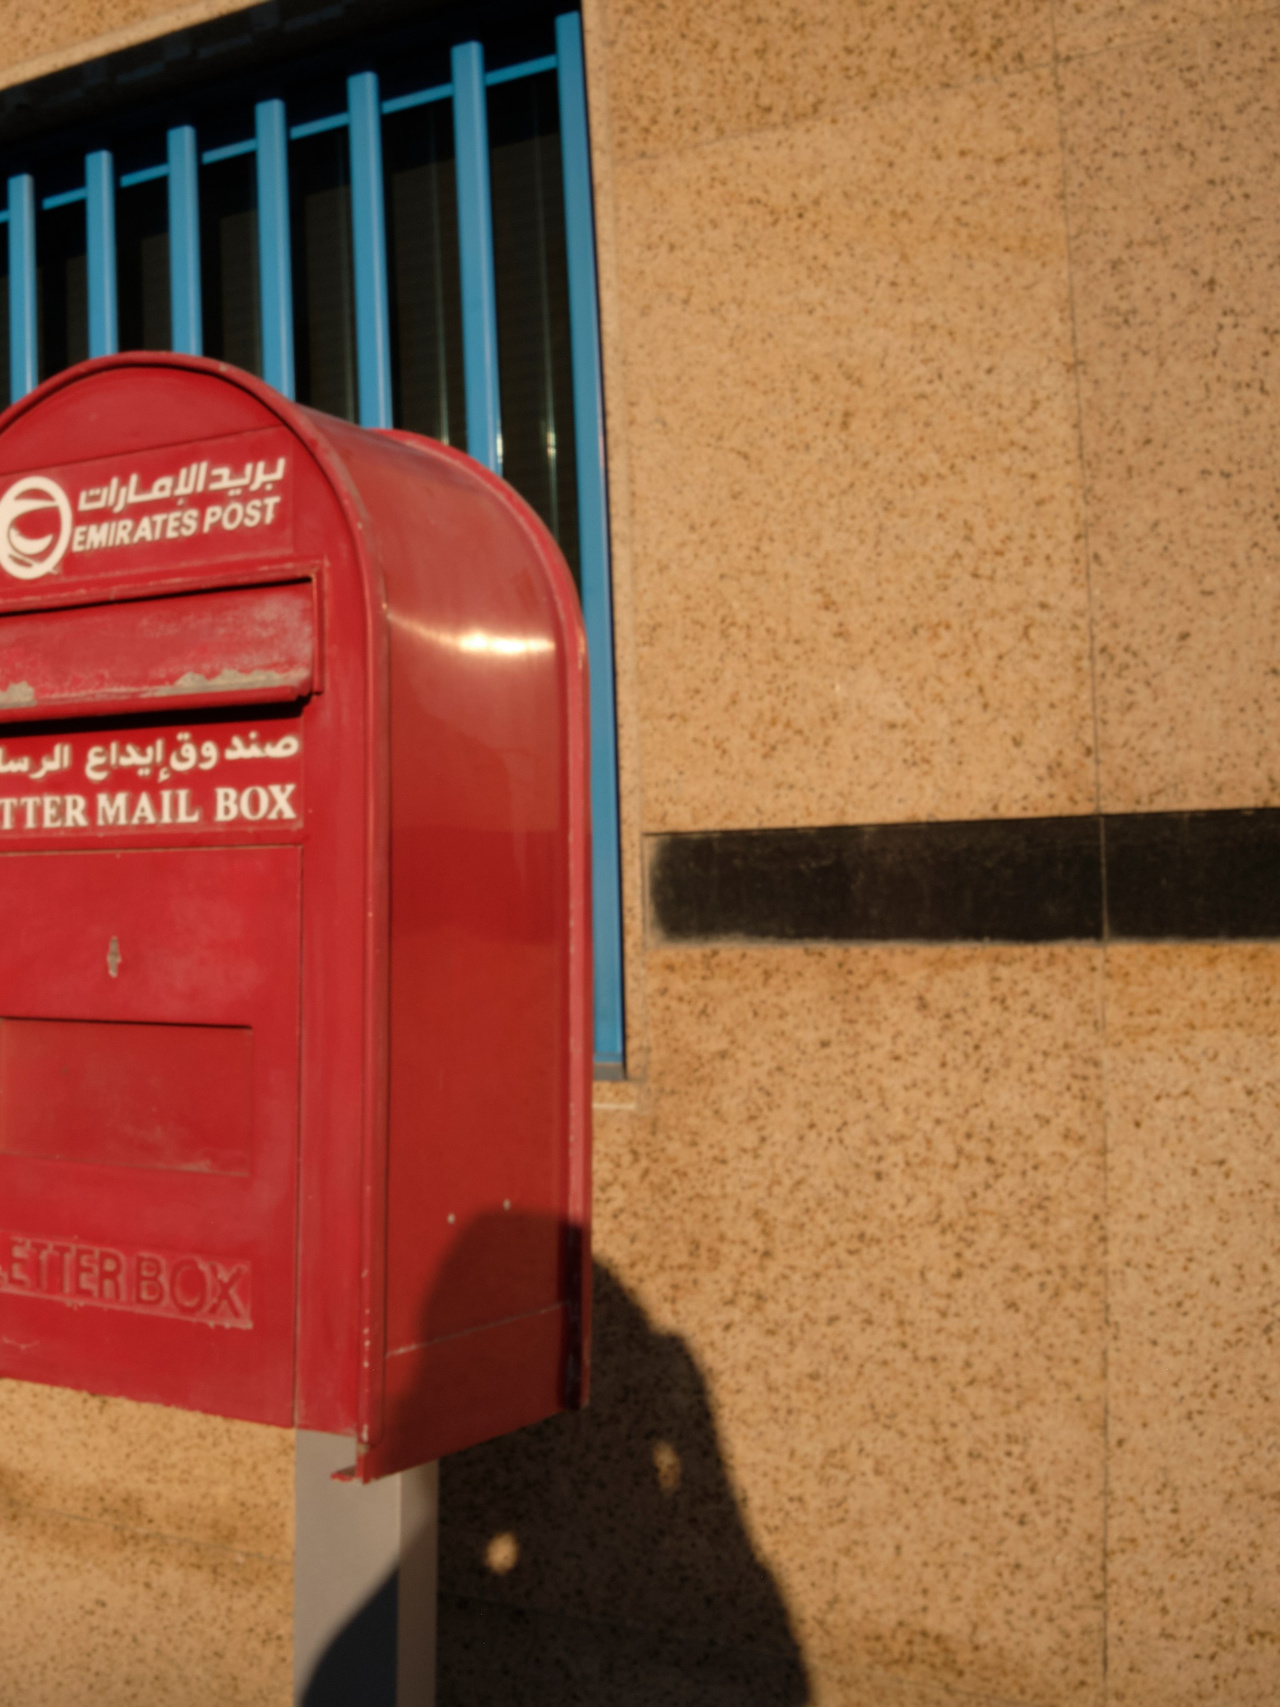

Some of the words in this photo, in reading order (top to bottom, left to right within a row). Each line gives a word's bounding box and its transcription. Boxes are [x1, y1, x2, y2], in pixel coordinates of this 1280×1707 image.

[209, 457, 286, 497] بريد
[72, 508, 200, 552] EMIRATES
[202, 496, 281, 534] POST
[84, 737, 170, 782] إيداع
[169, 730, 300, 772] صندوق
[96, 788, 200, 826] MAIL
[214, 783, 297, 822] BOX
[134, 1251, 248, 1321] BOX
